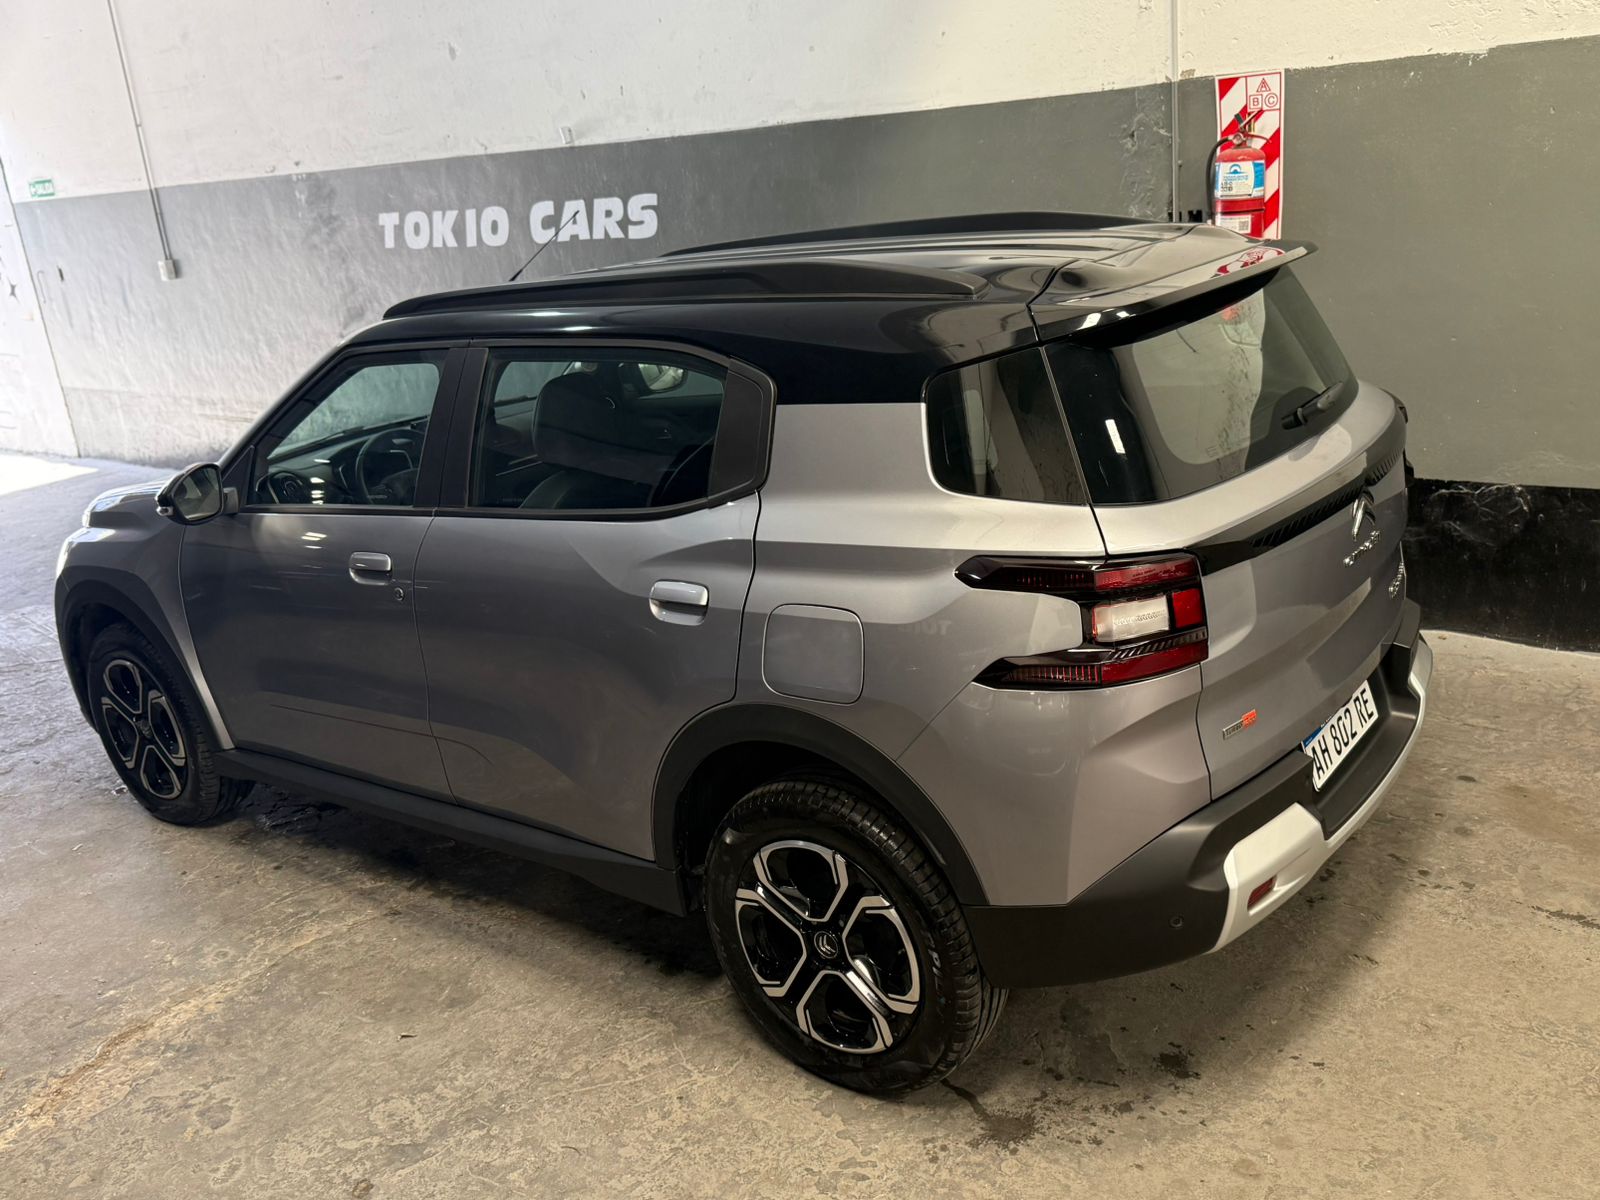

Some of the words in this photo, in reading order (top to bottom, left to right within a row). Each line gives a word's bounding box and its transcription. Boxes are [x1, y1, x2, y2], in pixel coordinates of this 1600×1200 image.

[1252, 97, 1260, 106] B
[1268, 96, 1275, 105] C
[378, 205, 510, 250] TOKIO
[529, 193, 658, 245] CARS
[1311, 734, 1333, 780] AH
[1330, 707, 1358, 756] 802
[1353, 688, 1374, 729] RE
